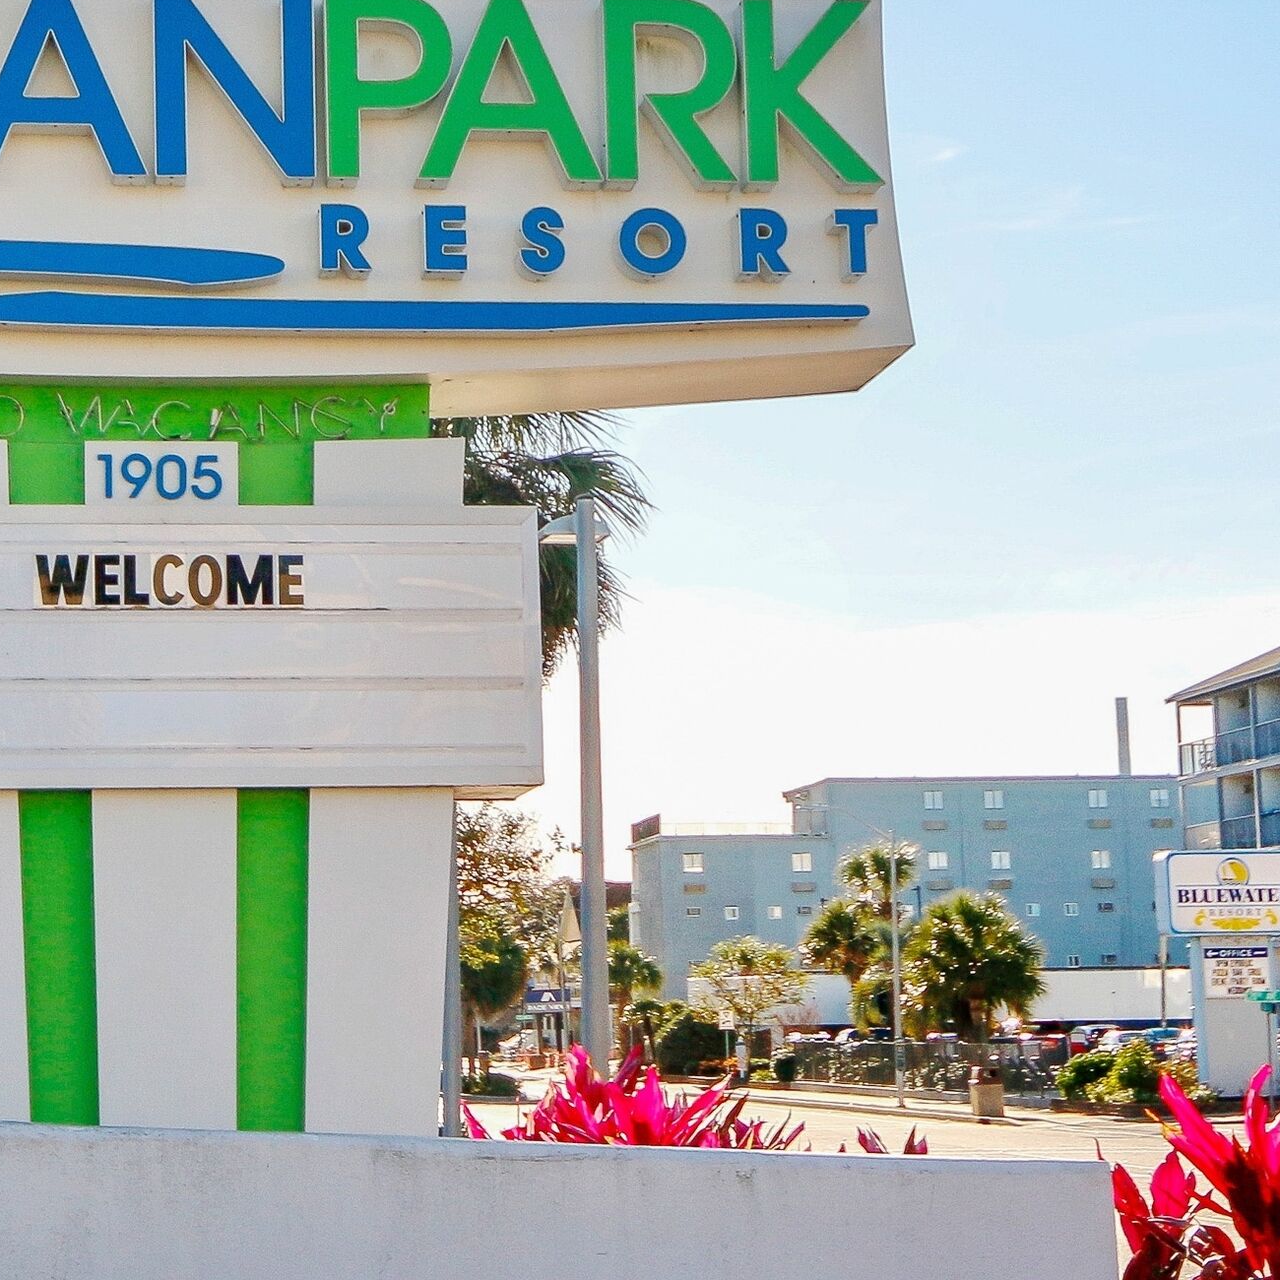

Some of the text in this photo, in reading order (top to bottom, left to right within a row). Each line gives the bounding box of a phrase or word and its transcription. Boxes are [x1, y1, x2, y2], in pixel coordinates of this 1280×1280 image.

[317, 204, 879, 283] RESORT
[56, 392, 398, 440] VACANCY
[97, 453, 222, 501] 1905
[35, 553, 305, 606] WELCOME
[1209, 908, 1262, 916] RESORT
[1220, 949, 1252, 957] OFFICE
